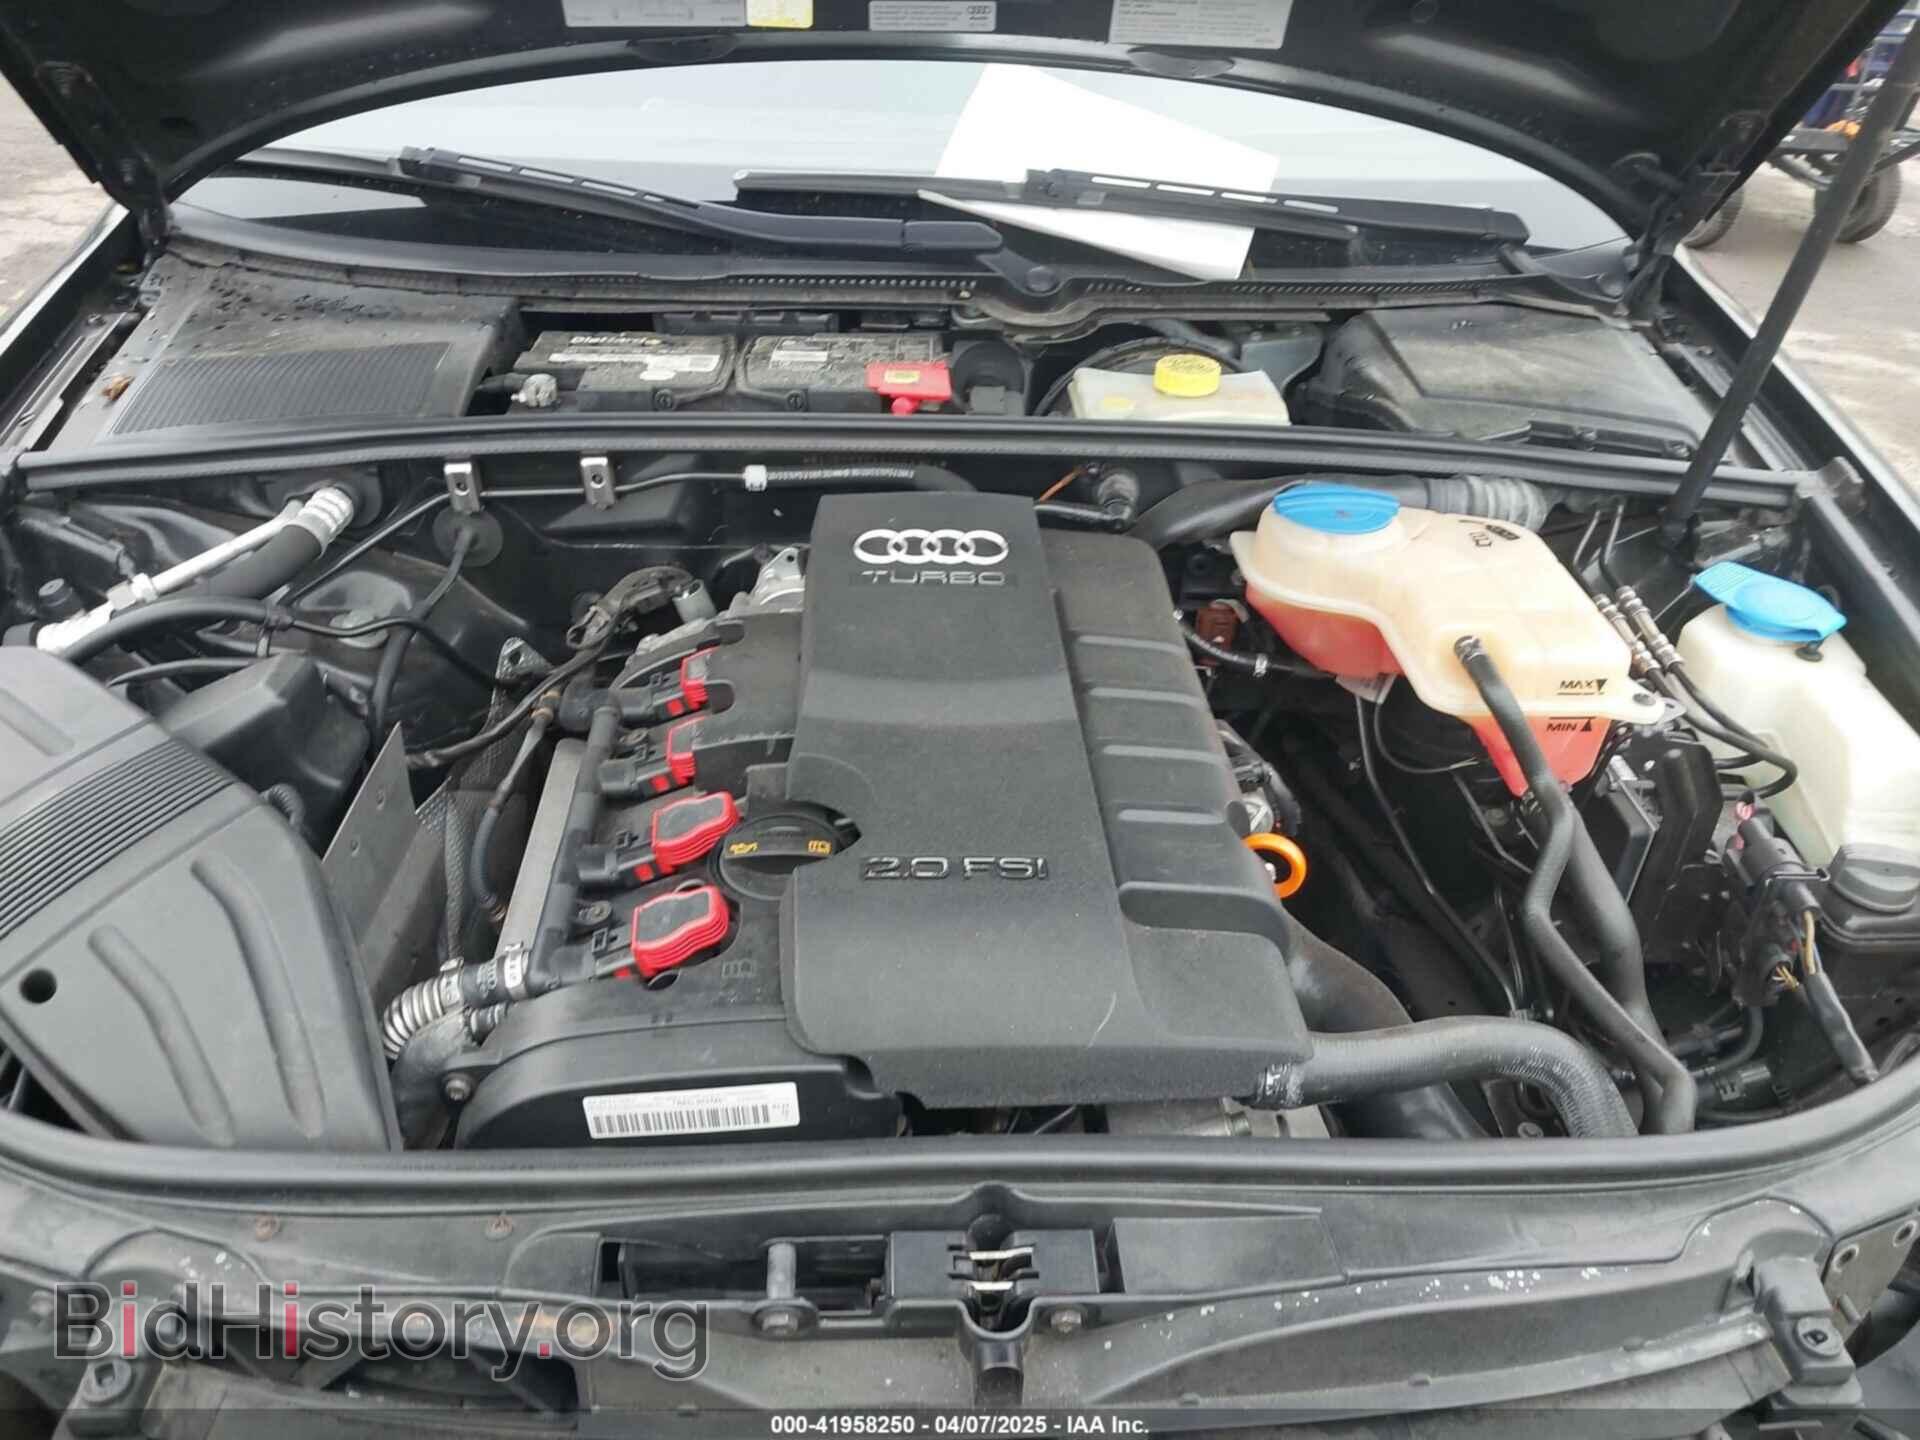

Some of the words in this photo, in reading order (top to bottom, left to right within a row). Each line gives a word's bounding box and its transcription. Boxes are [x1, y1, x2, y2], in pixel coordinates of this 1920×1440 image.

[861, 570, 1006, 585] TURBO
[1559, 680, 1594, 690] MAX
[1546, 722, 1577, 732] MIN
[863, 856, 949, 880] 2.0
[962, 856, 1049, 880] FSI
